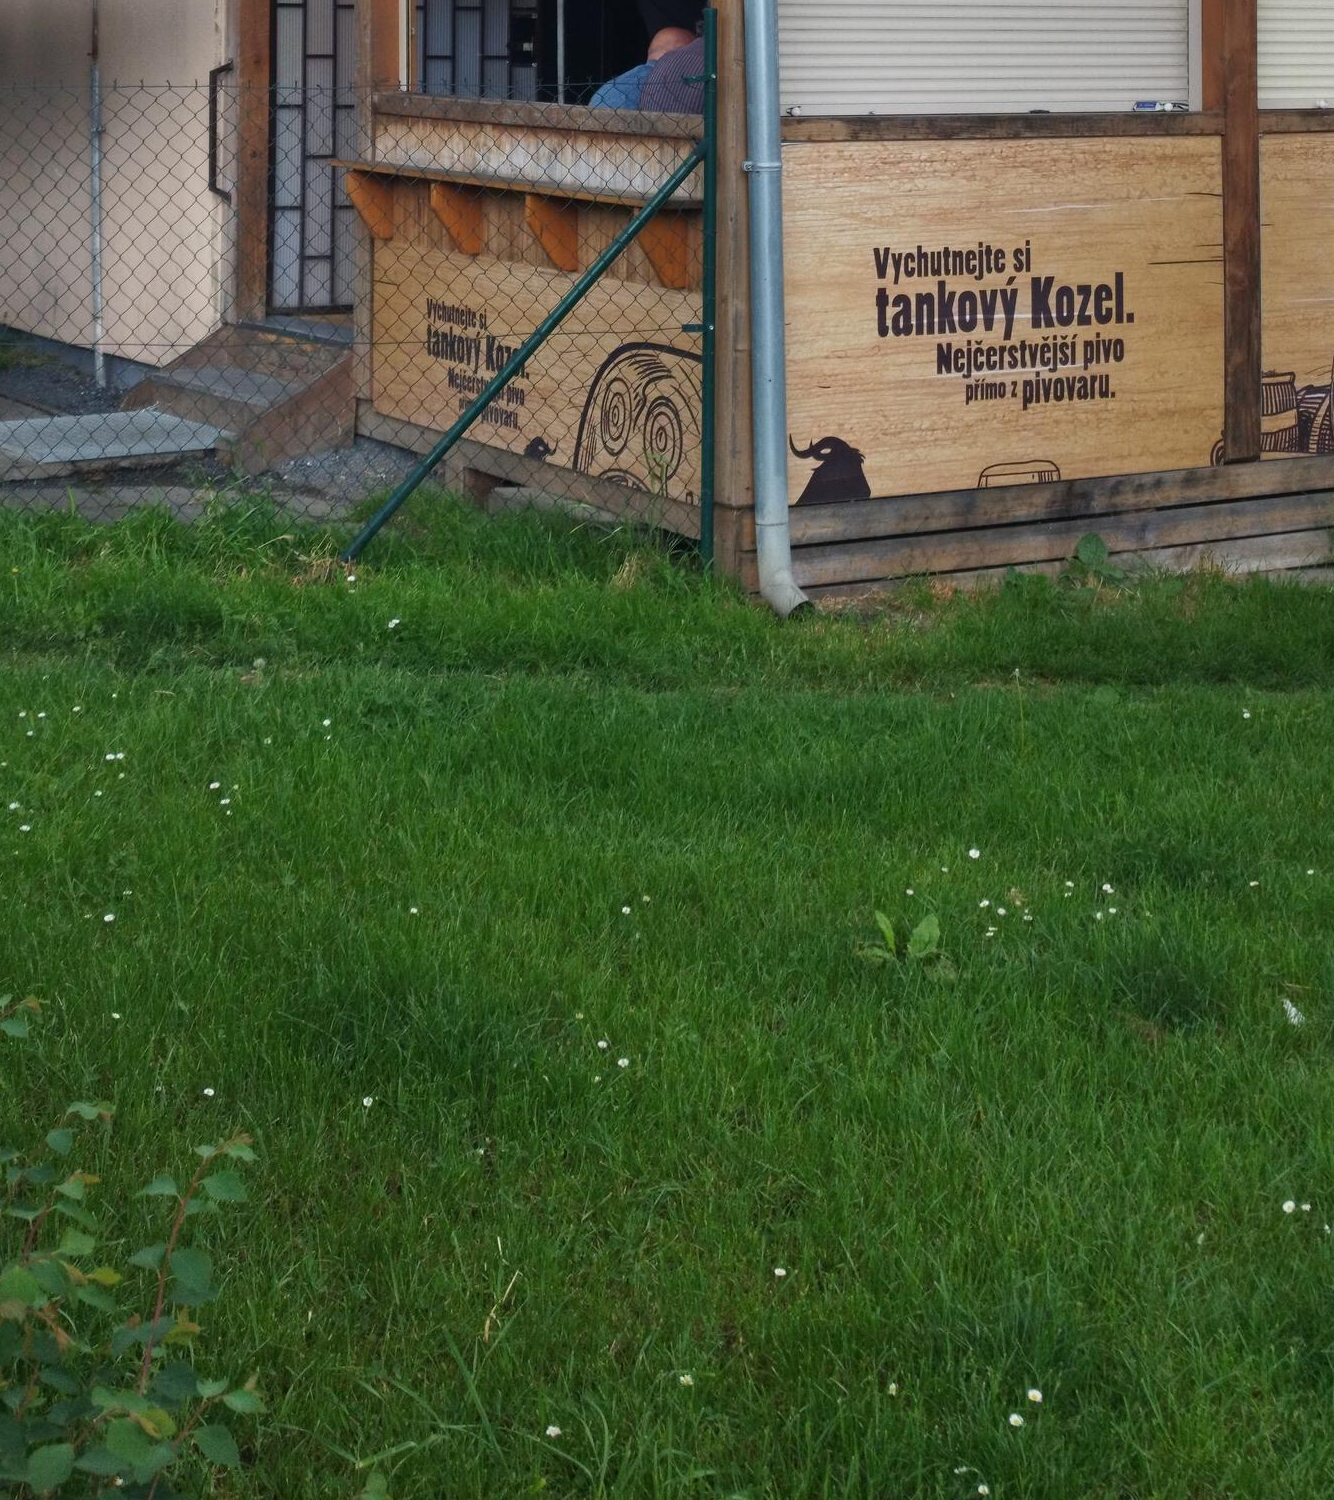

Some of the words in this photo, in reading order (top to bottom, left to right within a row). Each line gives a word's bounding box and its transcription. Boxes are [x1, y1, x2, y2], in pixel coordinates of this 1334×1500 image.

[873, 241, 1006, 284] Vychutnejte
[1013, 240, 1031, 273] si
[427, 298, 476, 330] Vychutnejte
[479, 309, 487, 331] si
[875, 276, 1019, 341] tankový
[1031, 272, 1134, 329] Kozel.
[427, 325, 480, 374] tankový
[937, 334, 1078, 378] Nejčerstvější
[1083, 332, 1124, 370] pivo
[507, 382, 524, 406] pivo
[966, 378, 1006, 405] přímo
[1011, 380, 1018, 397] z
[1022, 372, 1116, 411] pivovaru.
